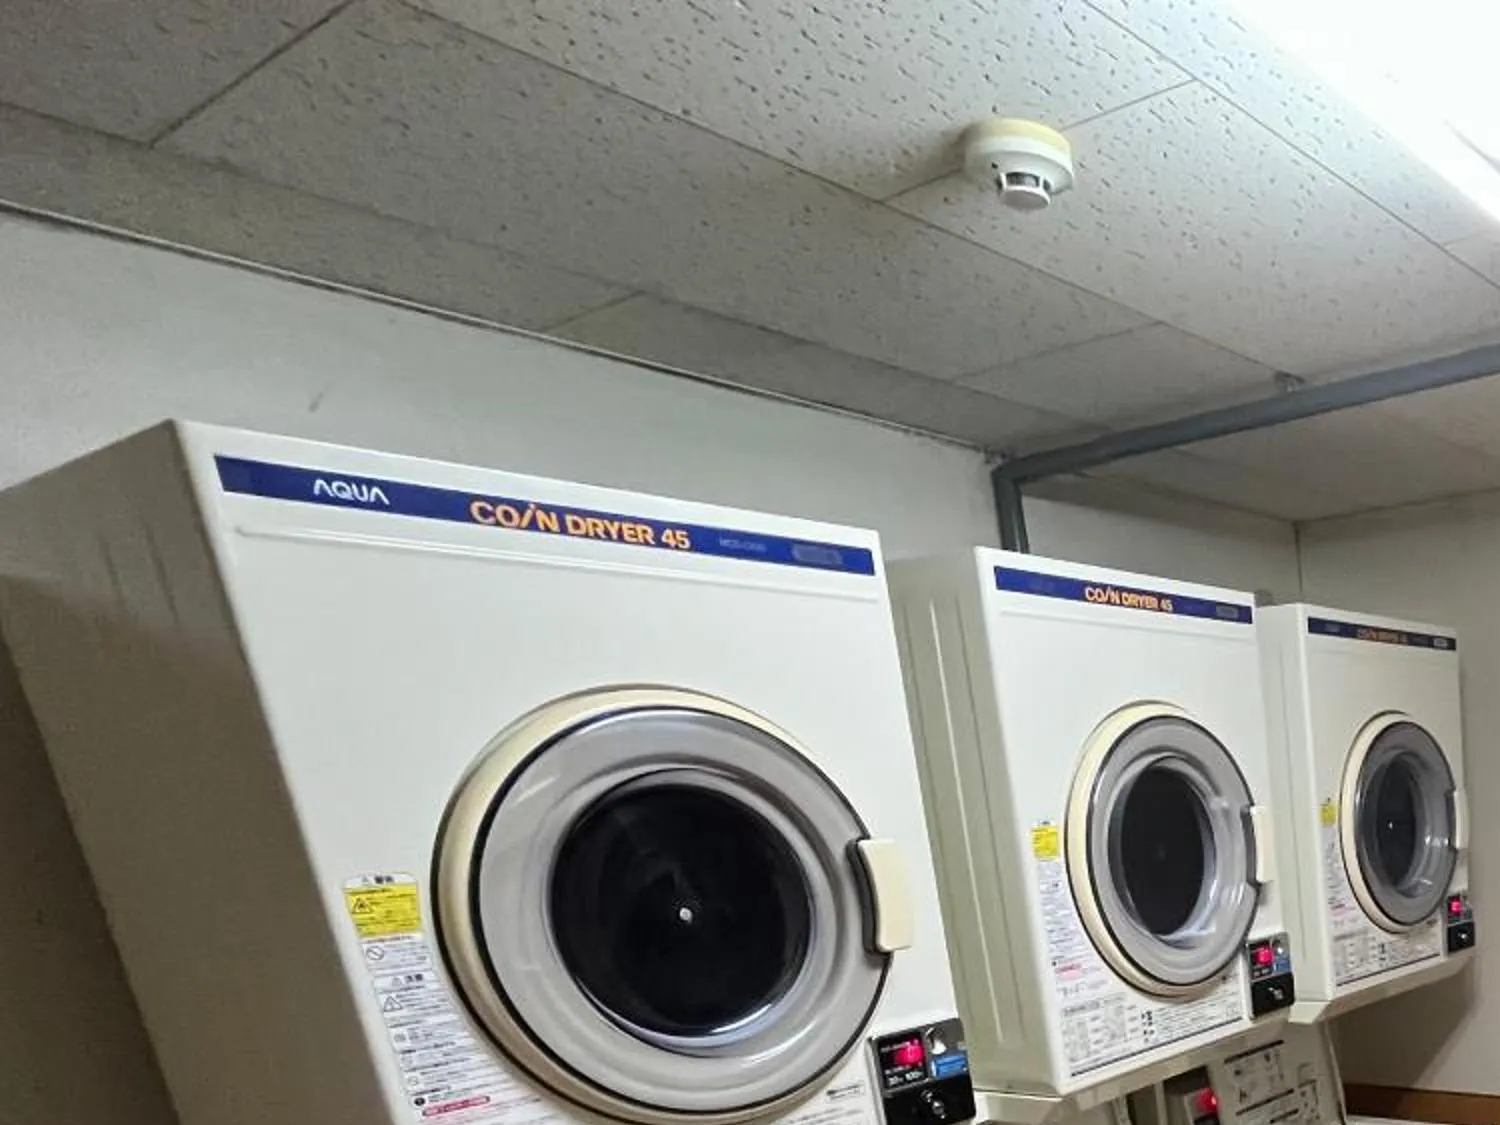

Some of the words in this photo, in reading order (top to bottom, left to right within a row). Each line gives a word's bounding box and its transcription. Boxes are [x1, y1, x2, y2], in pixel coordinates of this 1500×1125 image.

[313, 478, 390, 505] AQUA
[564, 513, 655, 545] DRYER
[661, 528, 692, 550] 45
